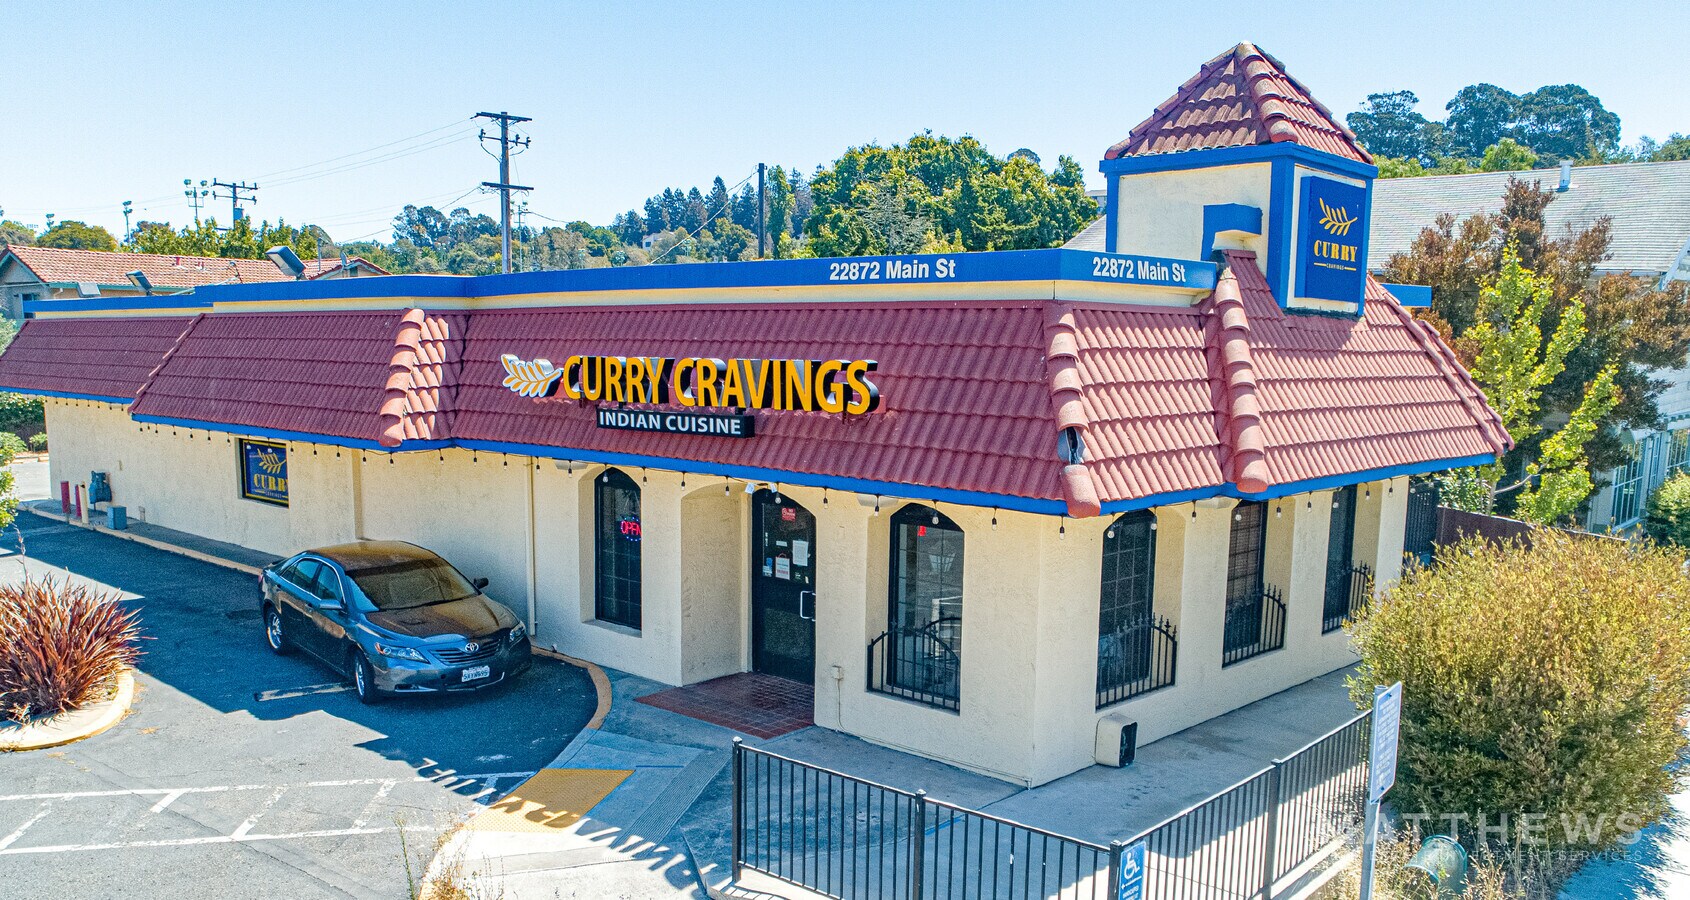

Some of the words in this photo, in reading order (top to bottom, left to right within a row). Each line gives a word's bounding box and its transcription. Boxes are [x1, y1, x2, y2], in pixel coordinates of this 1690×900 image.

[1313, 240, 1358, 262] CURRY
[829, 261, 880, 281] 22872
[886, 259, 930, 279] Main
[935, 258, 956, 278] St
[1092, 256, 1135, 279] 22872
[1137, 260, 1169, 281] Main
[1172, 262, 1187, 282] St
[563, 355, 669, 405] CURRY
[674, 357, 879, 415] CRAVINGS
[599, 411, 661, 430] INDIAN
[665, 415, 741, 436] CUISINE
